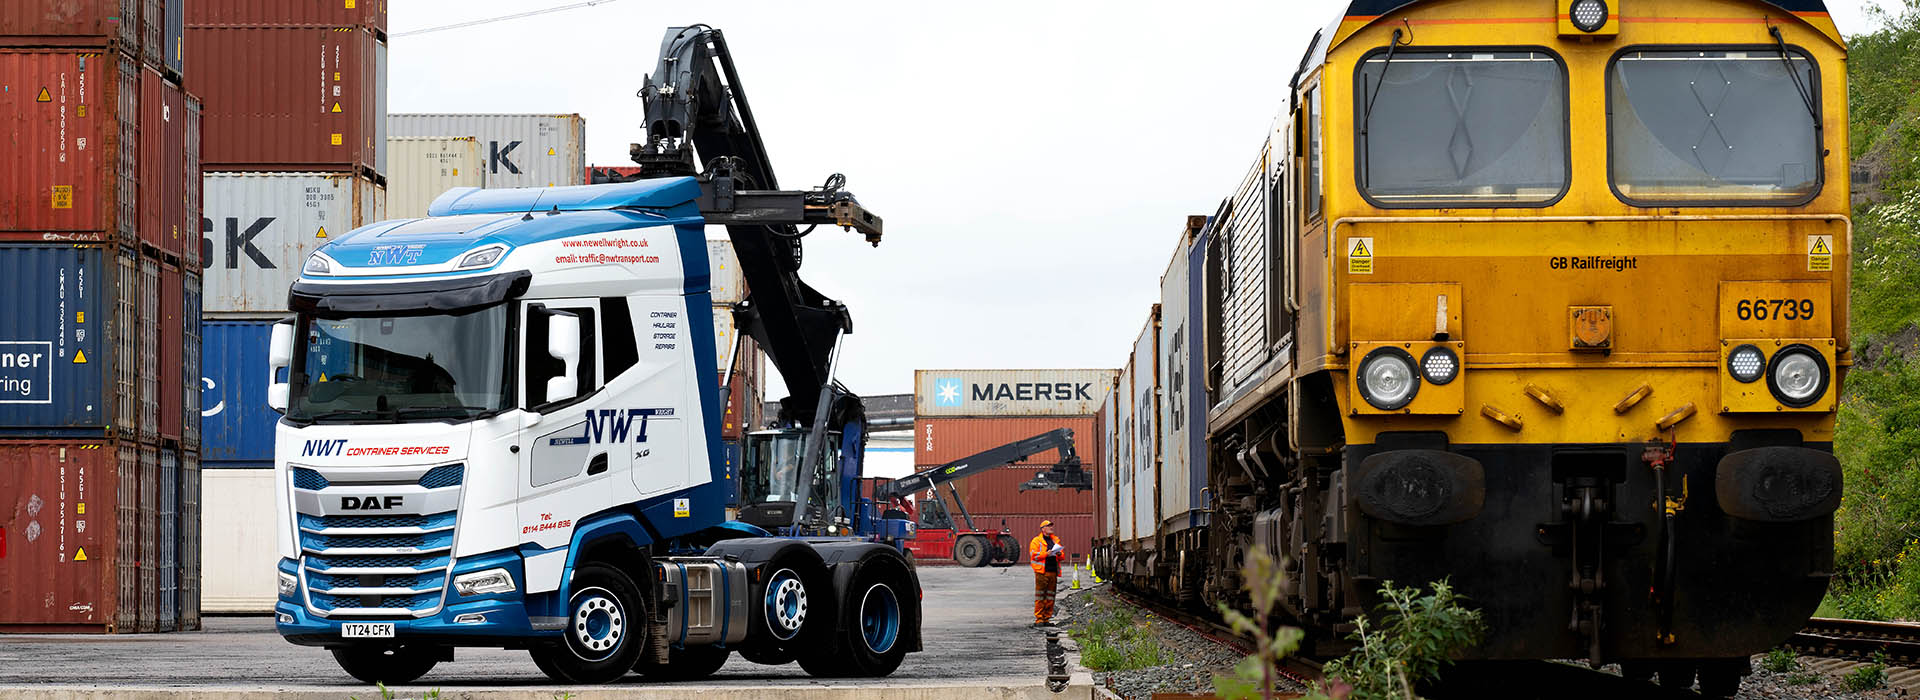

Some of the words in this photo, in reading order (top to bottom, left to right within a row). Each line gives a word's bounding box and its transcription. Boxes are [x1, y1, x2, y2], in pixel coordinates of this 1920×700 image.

[203, 217, 277, 269] K
[562, 238, 649, 249] www.newellwright.co.uk
[368, 247, 424, 265] NWT
[555, 253, 578, 264] email:
[579, 253, 660, 264] traffic@nwtransport.com
[1550, 256, 1568, 269] GB
[1571, 256, 1637, 272] Railfreight
[1737, 299, 1814, 321] 66739
[971, 382, 1093, 401] MAERSK
[584, 408, 657, 444] NWT
[301, 439, 349, 457] NWT
[346, 447, 400, 457] CONTAINER
[400, 446, 450, 455] SERVICES
[341, 496, 403, 510] DAF
[522, 526, 538, 534] 0114
[346, 624, 370, 636] YT24
[372, 624, 391, 636] CFK
